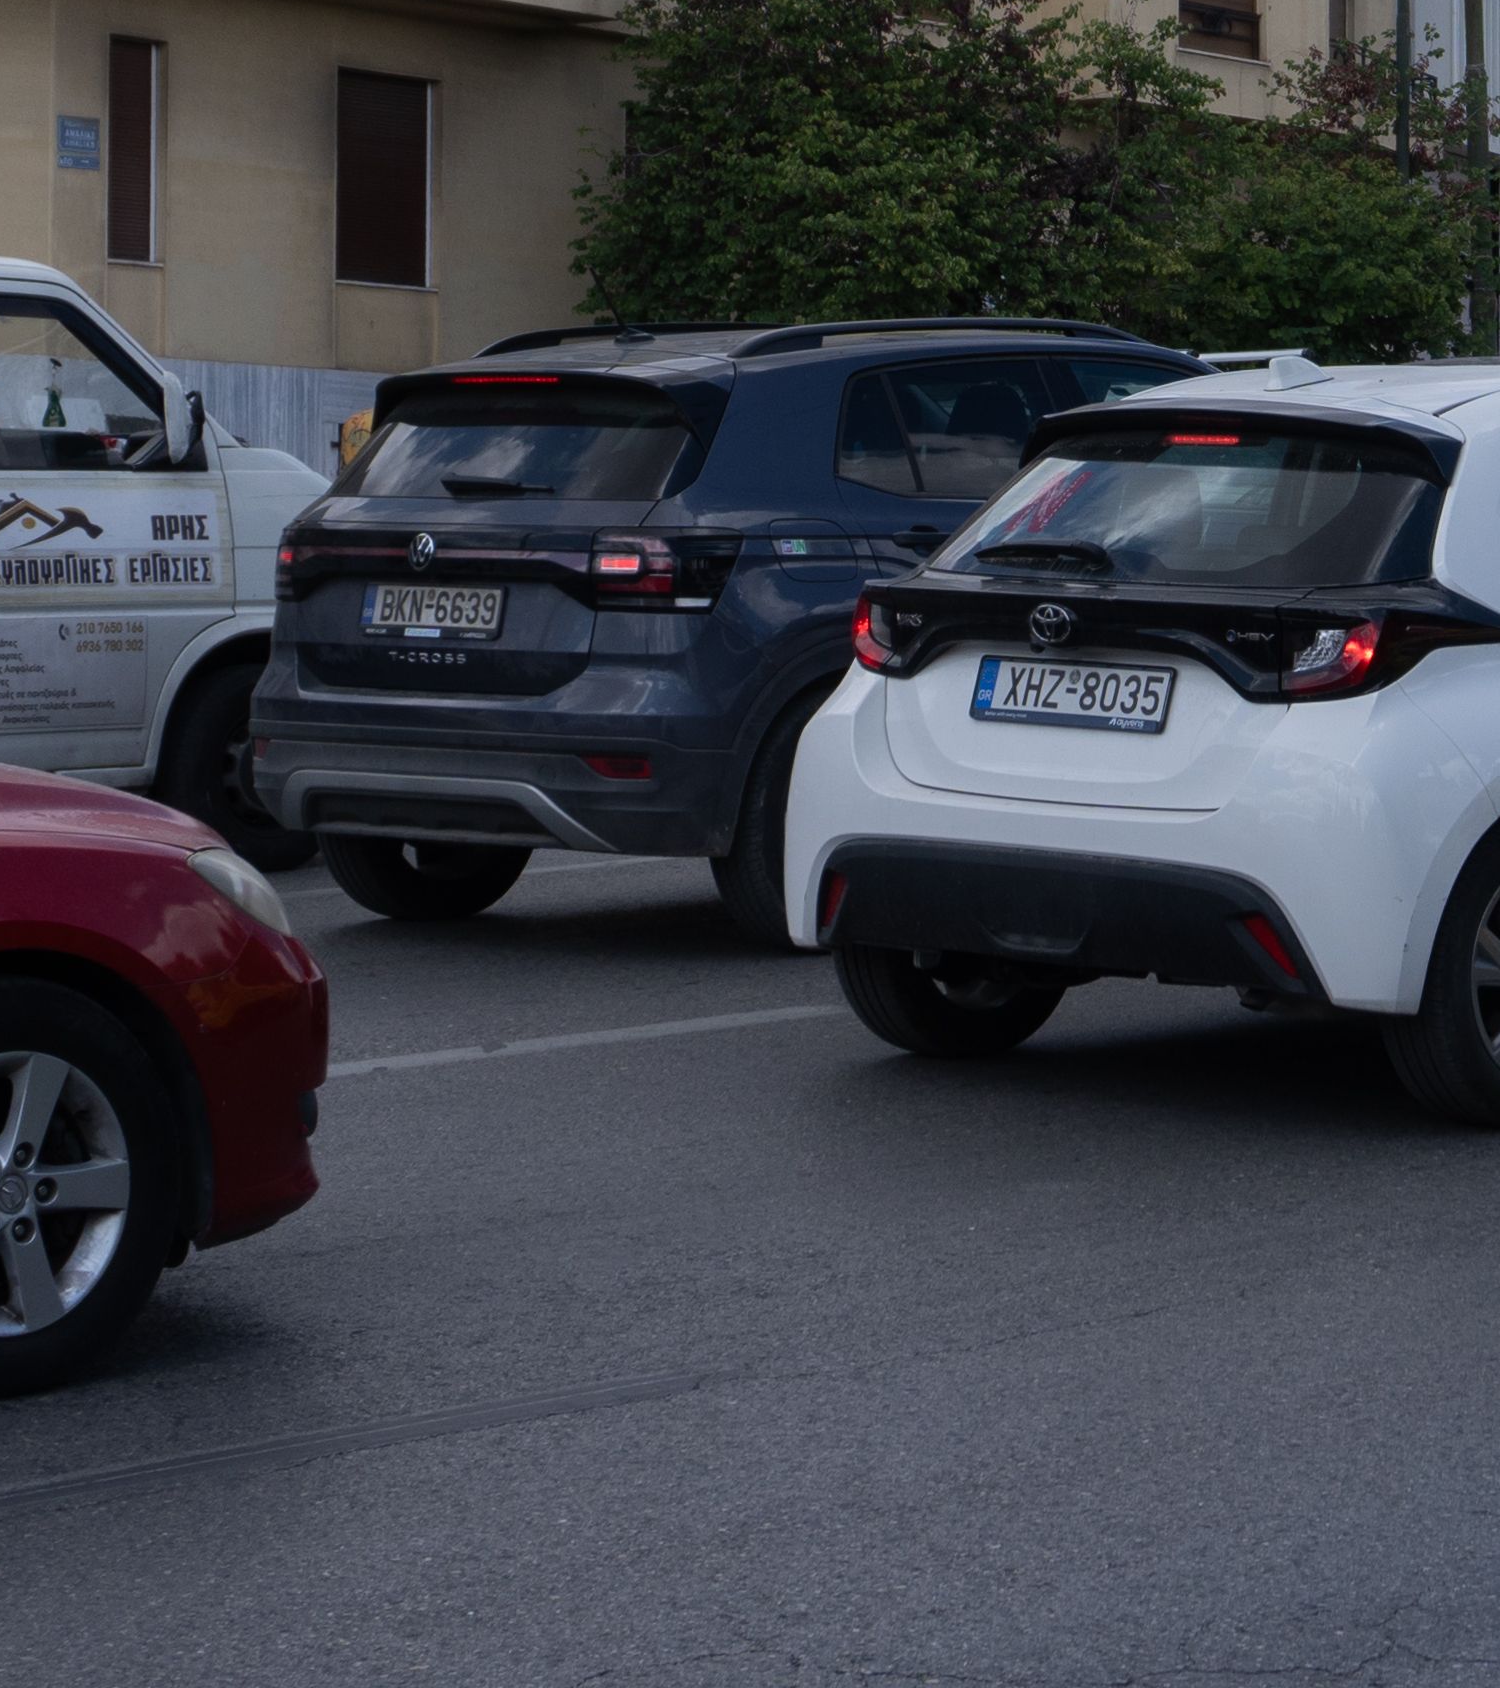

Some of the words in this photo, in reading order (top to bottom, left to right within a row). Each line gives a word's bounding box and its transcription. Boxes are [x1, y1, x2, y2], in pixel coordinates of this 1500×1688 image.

[150, 514, 209, 540] ΑΡΗΣ
[128, 552, 212, 583] ΕΡΓΑΣΙΕΣ
[380, 589, 497, 625] BKN-6639
[76, 622, 96, 634] 210
[98, 622, 123, 634] 7650
[125, 621, 144, 633] 166
[76, 640, 101, 653] 6936
[104, 640, 123, 652] 780
[125, 639, 144, 651] 302
[388, 651, 467, 664] T-CROSS
[977, 688, 993, 701] GR
[1003, 666, 1165, 716] XHZ-8035
